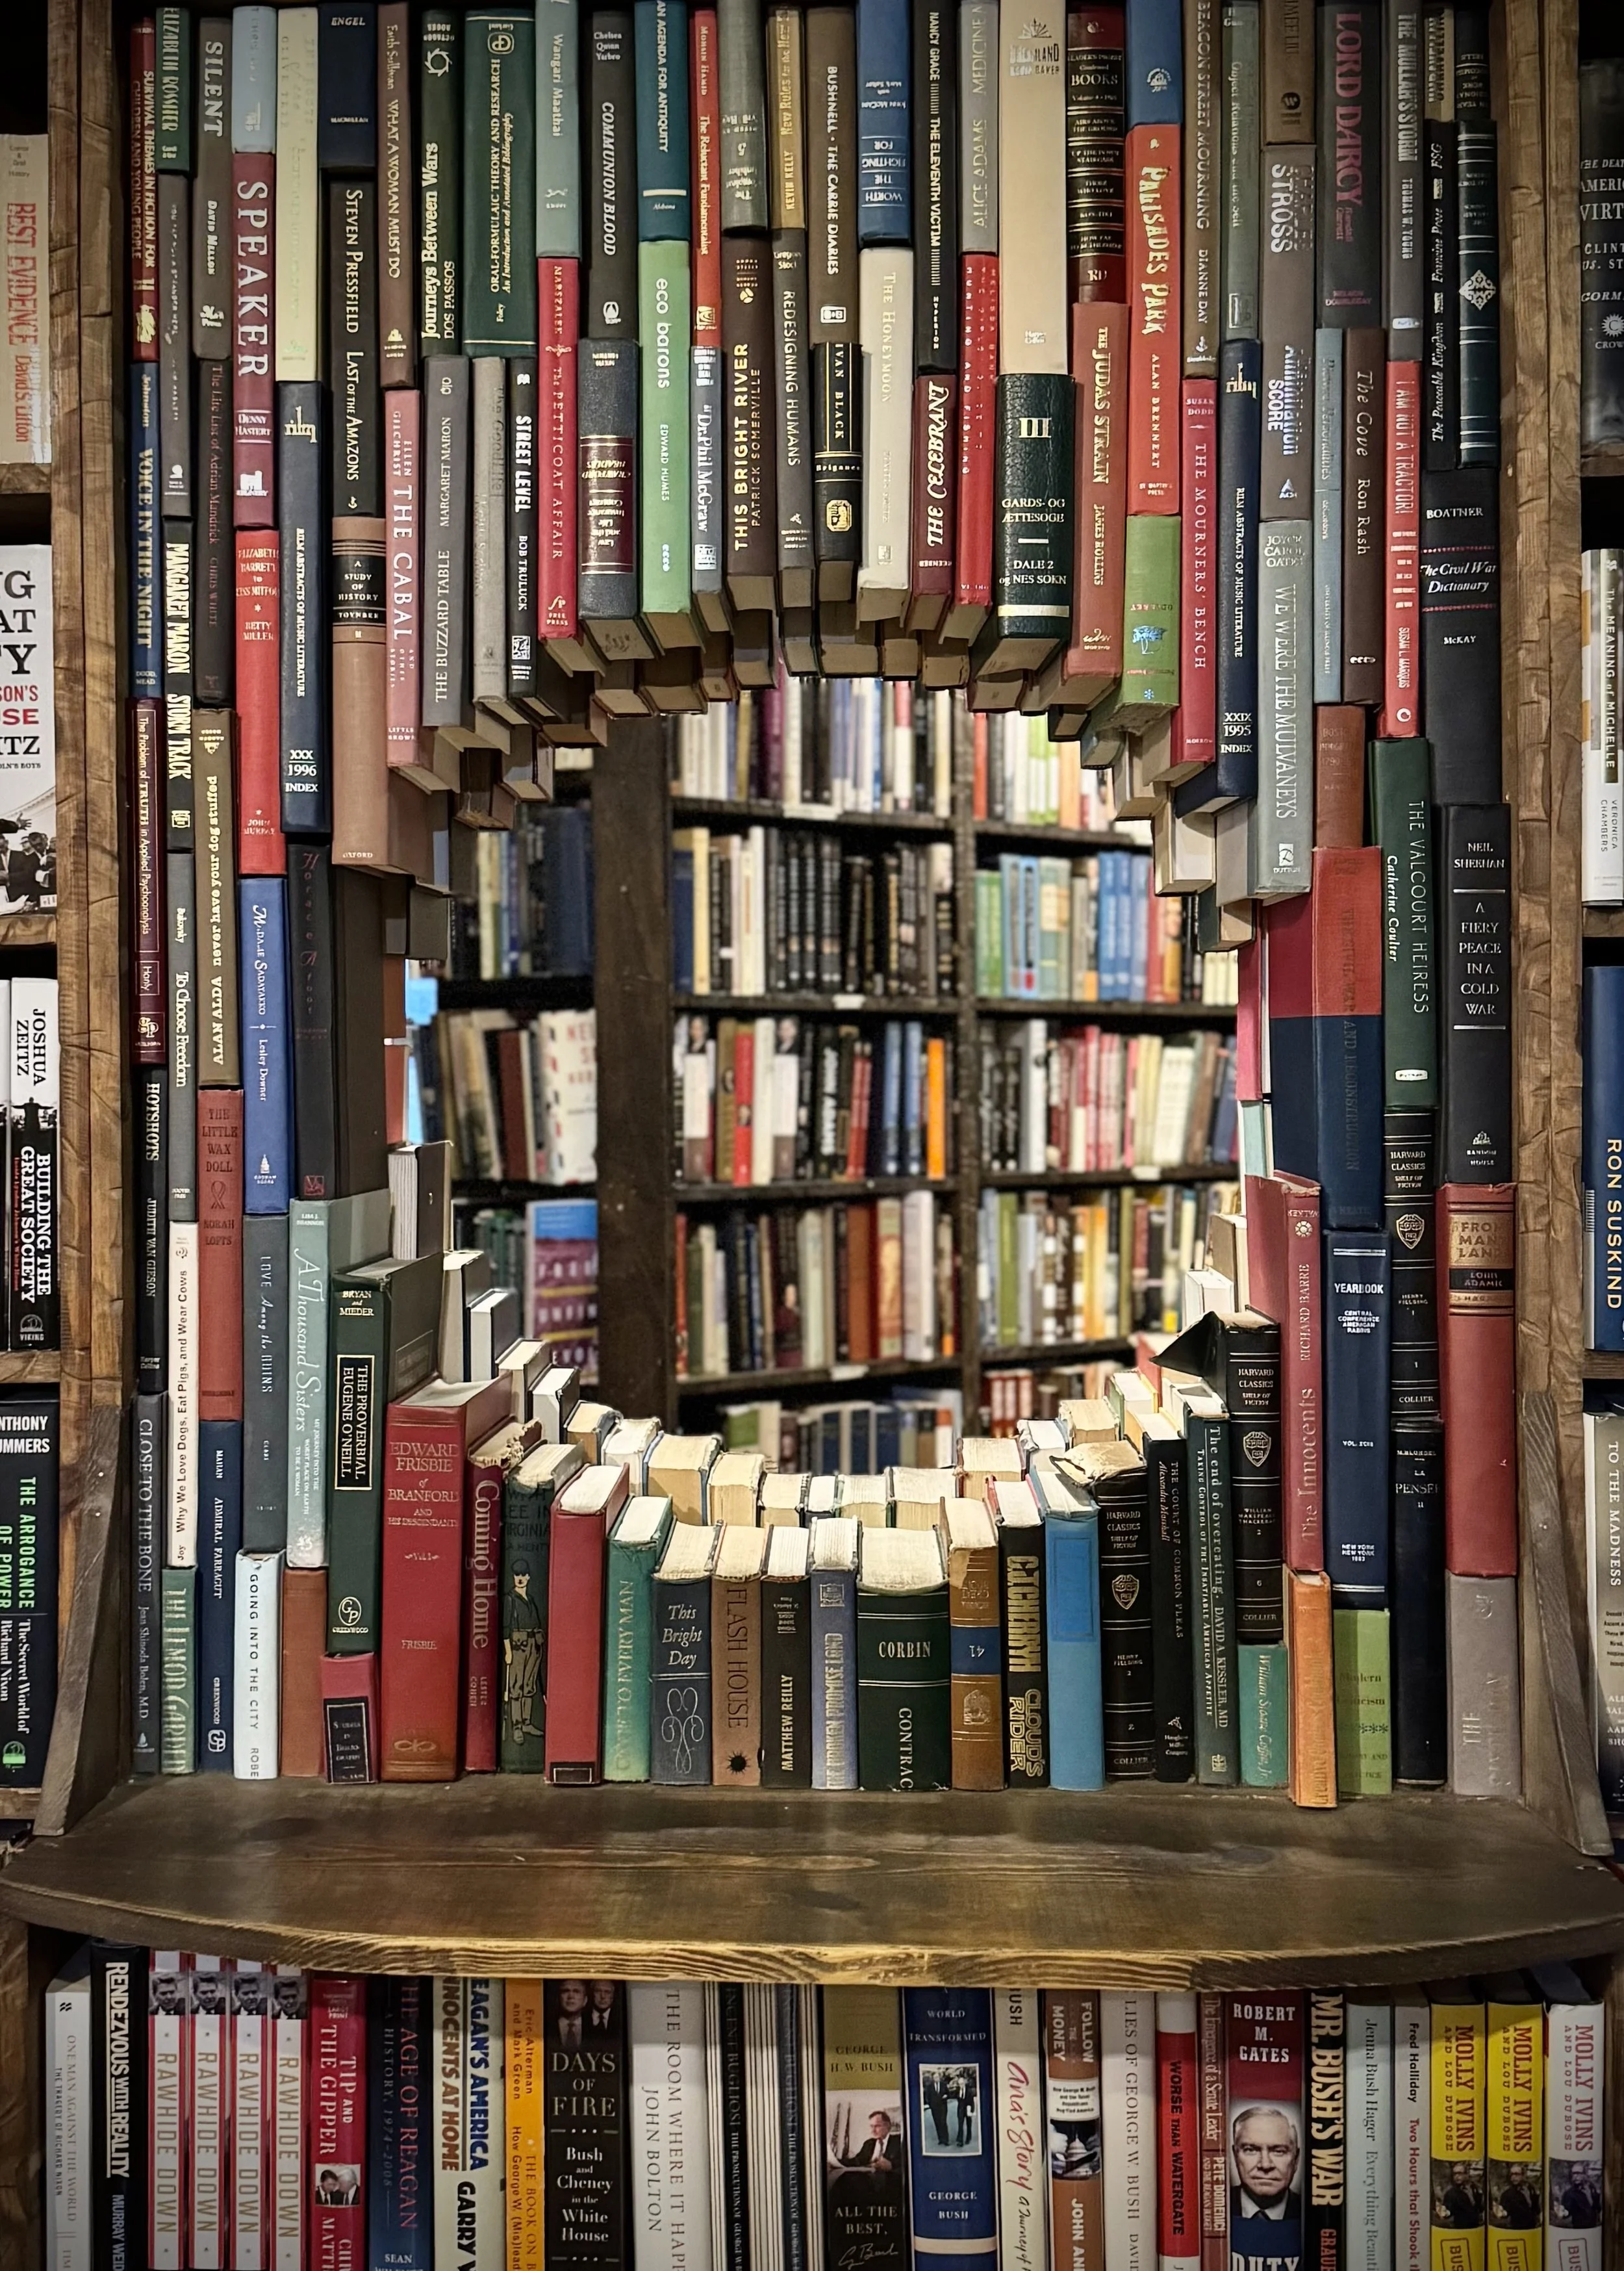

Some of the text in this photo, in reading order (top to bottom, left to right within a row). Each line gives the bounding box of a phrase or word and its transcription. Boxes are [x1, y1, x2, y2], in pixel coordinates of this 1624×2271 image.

[204, 42, 222, 136] SILENT
[1336, 13, 1362, 206] LORD DARCY
[144, 71, 156, 267] SURVIVAL THEMES IN FICTION FOR
[602, 103, 616, 255] COMMUNION BLOOD
[1271, 164, 1293, 252] STROSS
[8, 203, 38, 344] BEST EVIDENCE
[236, 181, 268, 378] SPEAKER
[346, 190, 363, 333] STEVEN PRESSFIELD
[1139, 167, 1171, 335] PALISADES PARK
[346, 352, 363, 384] LAST
[655, 278, 672, 388] eco barons
[346, 415, 363, 480] AMAZONS
[347, 396, 356, 413] THE
[735, 344, 748, 550] THIS BRIGHT RIVER
[516, 416, 532, 512] STREET LEVEL
[1357, 480, 1371, 555] Ron Rash
[137, 450, 153, 647] VOICE IN THE NIGHT
[393, 487, 412, 639] THE CABAL
[1195, 443, 1206, 669] THE MOURNERS' BENCH
[166, 543, 189, 673] MARGARET MARON
[436, 551, 450, 702] THE BUZZARD TABLE
[139, 717, 150, 733] The
[139, 736, 149, 767] Problem
[167, 694, 191, 779] STORM TRACK
[1275, 585, 1297, 818] WE WERE THE MULVANEYS
[139, 770, 149, 779] of
[140, 782, 149, 825] TRUTH
[138, 839, 150, 871] Applied
[139, 873, 151, 934] Psychoanalysis
[1386, 855, 1399, 961] Catherine Coulter
[1408, 801, 1428, 1013] THE VALCOURT HEIRESS
[1459, 942, 1501, 954] PEACE
[1462, 922, 1499, 933] FIERY
[175, 971, 190, 1086] To Choose Freedom
[1460, 983, 1499, 994] COLD
[1465, 1004, 1496, 1015] WAR
[17, 1020, 29, 1076] ZEITZ
[32, 1009, 45, 1085] JOSHUA
[21, 1146, 34, 1303] GREAT SOCIETY
[36, 1153, 51, 1294] BUILDING THE
[1607, 1139, 1623, 1309] RON SUSKIND
[294, 1249, 325, 1430] A Thousand Sisters
[341, 1367, 353, 1477] EUGENE O'NEILL
[355, 1366, 368, 1479] THE PROVERBIAL
[19, 1478, 35, 1608] THE ARROGANCE
[139, 1419, 152, 1591] CLOSE TO THE BONE
[1608, 1442, 1621, 1586] TO THE MADNESS
[249, 1574, 259, 1729] GOING INTO THE CITY
[473, 1578, 493, 1648] Home
[662, 1628, 702, 1647] Bright
[668, 1604, 697, 1620] This
[668, 1650, 697, 1668] Day
[726, 1588, 748, 1728] FLASH HOUSE
[878, 1641, 931, 1658] CORBIN
[781, 1675, 794, 1770] MATTHEW REILLY
[1009, 1697, 1024, 1771] RIDER
[107, 1963, 129, 2177] RENDEZVOUS WITH REALITY
[320, 2025, 336, 2154] THE GIPPER
[339, 2056, 357, 2123] TIP AND
[553, 2053, 616, 2072] DAYS
[553, 2098, 616, 2117] FIRE
[666, 1990, 684, 2213] THE ROOM WHERE IT
[1125, 2000, 1140, 2220] LIES OF GEORGE W. BUSH
[1171, 2060, 1182, 2113] WORSE
[1239, 2047, 1289, 2062] GATES
[1312, 1994, 1343, 2206] MR. BUSH'S WAR
[1408, 2023, 1419, 2103] Fred Halliday
[1456, 2025, 1474, 2152] MOLLY IVINS
[1514, 2027, 1532, 2152] MOLLY IVINS
[1575, 2025, 1593, 2151] MOLLY IVINS
[157, 2053, 177, 2233] RAWHIDE DOWN
[197, 2053, 218, 2232] RAWHIDE DOWN
[238, 2053, 259, 2233] RAWHIDE DOWN
[278, 2057, 299, 2238] RAWHIDE DOWN
[400, 2028, 418, 2228] AGE OF REAGAN
[642, 2087, 661, 2231] JOHN BOLTON
[1172, 2152, 1184, 2235] WATERGATE
